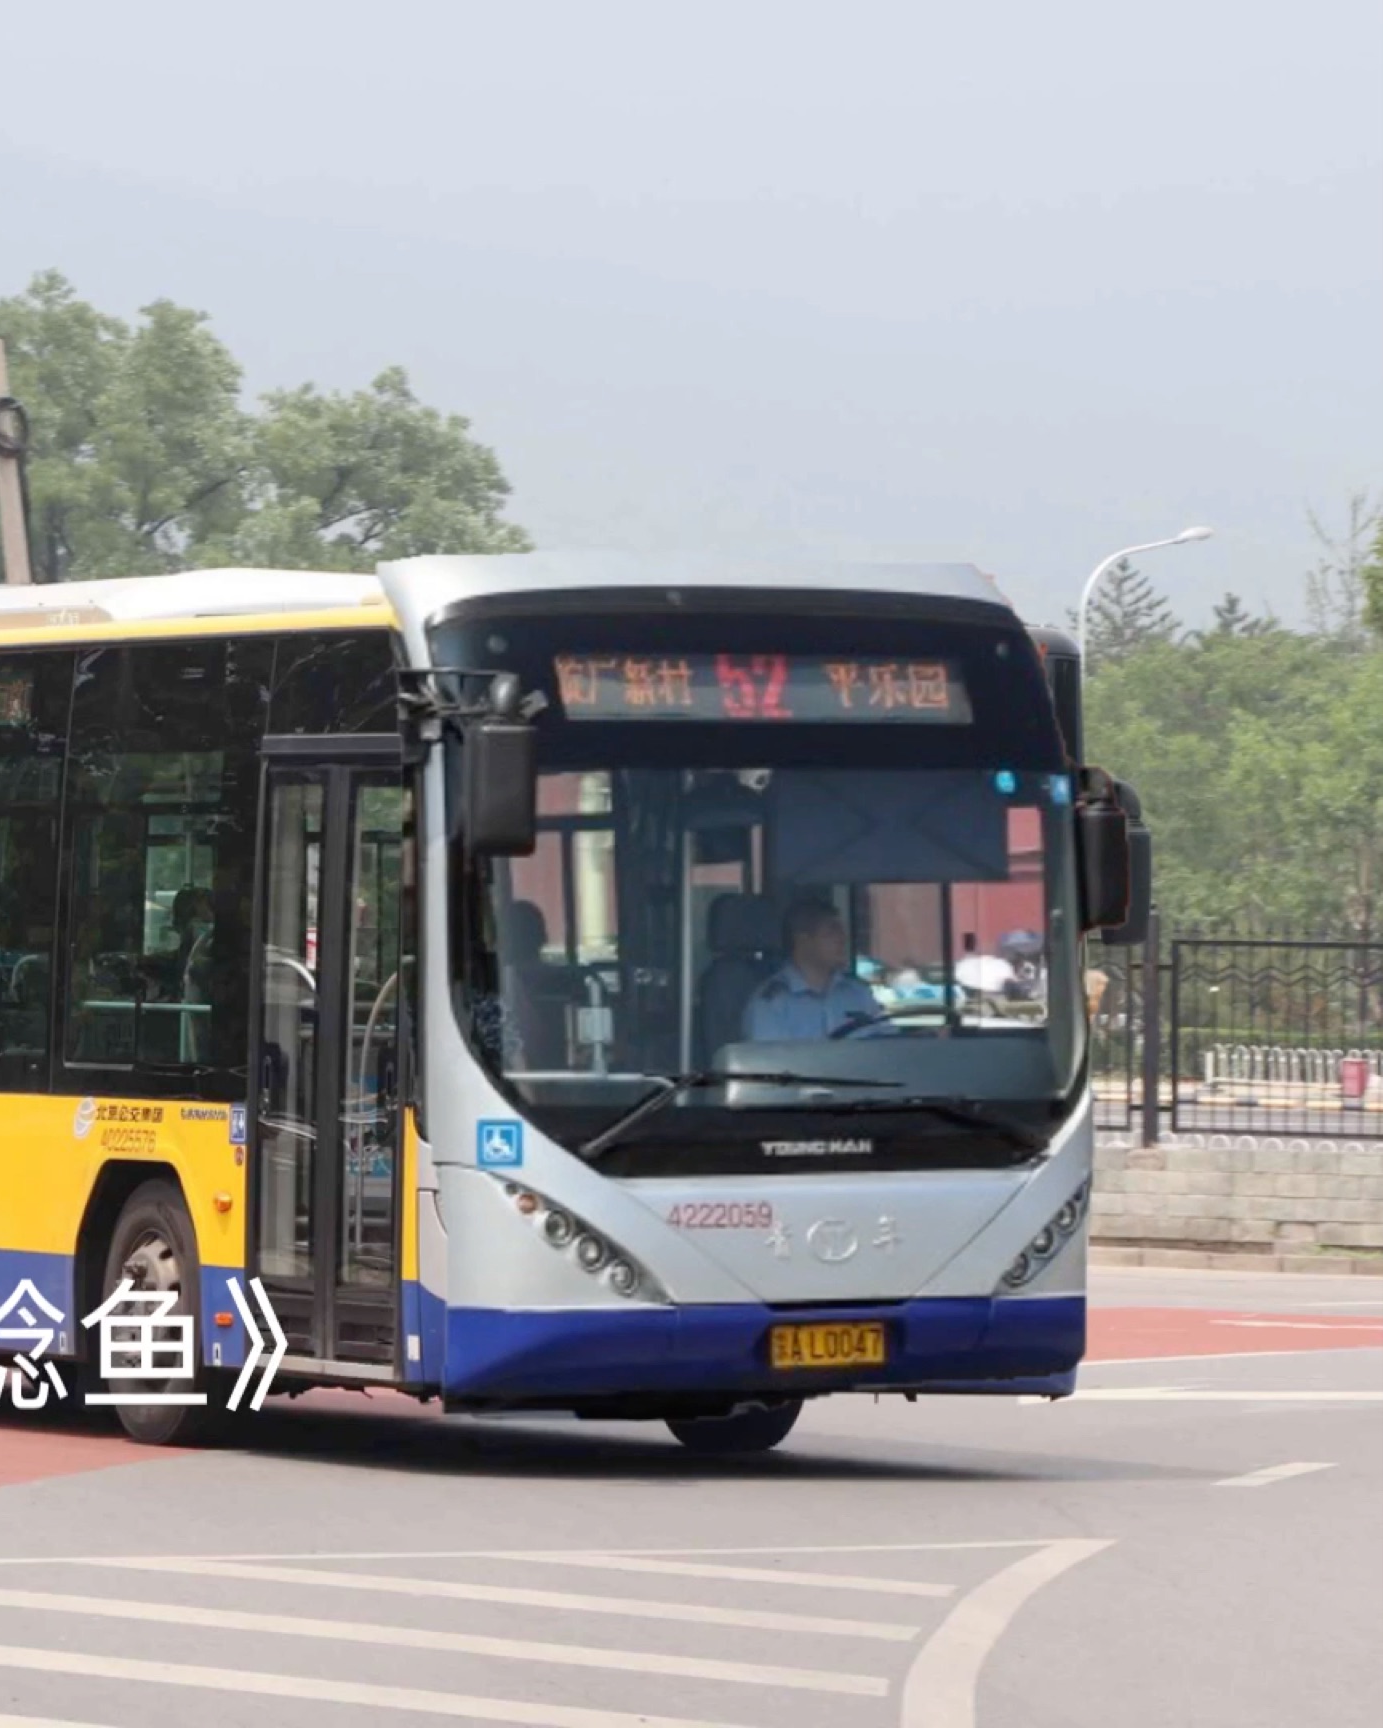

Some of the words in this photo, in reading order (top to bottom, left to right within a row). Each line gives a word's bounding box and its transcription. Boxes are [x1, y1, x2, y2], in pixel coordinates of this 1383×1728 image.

[713, 653, 792, 719] 52
[824, 662, 950, 709] 平乐园
[667, 1202, 773, 1229] 4222059
